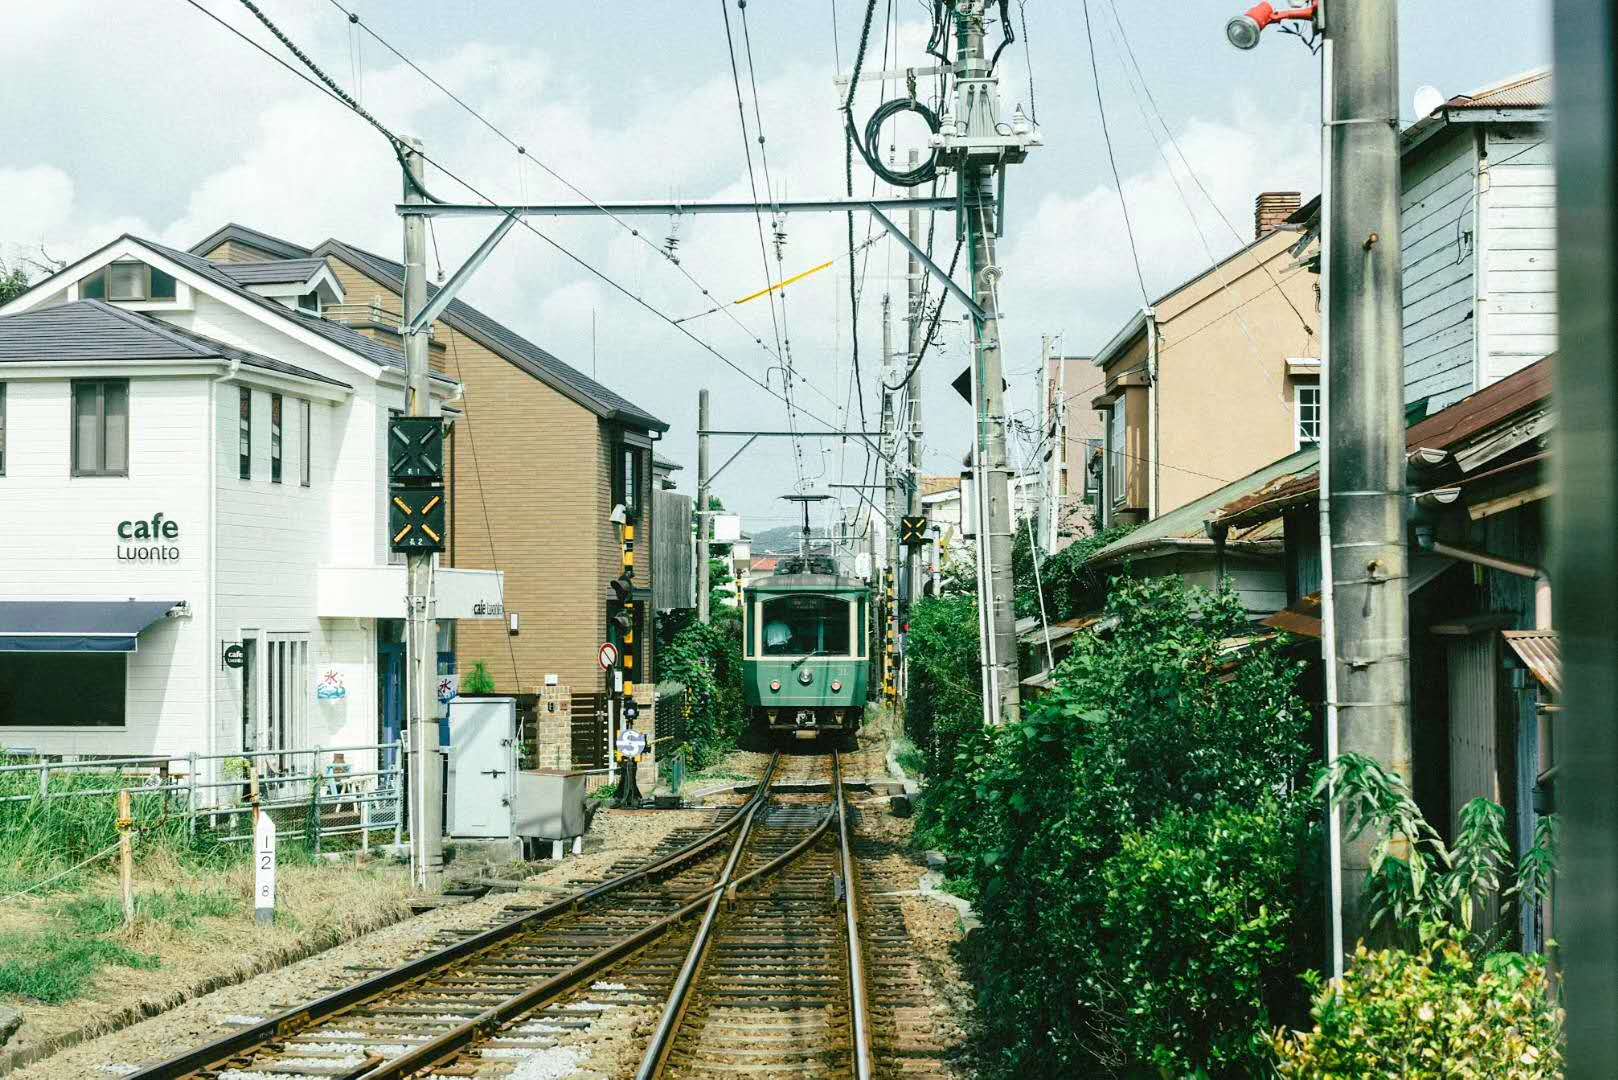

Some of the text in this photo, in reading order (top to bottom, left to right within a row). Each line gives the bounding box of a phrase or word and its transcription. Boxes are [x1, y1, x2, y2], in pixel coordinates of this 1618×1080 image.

[117, 512, 179, 539] cafe
[117, 545, 179, 560] Luonto
[473, 600, 486, 615] cafe
[439, 678, 451, 693] 氷
[261, 856, 271, 870] 2
[262, 885, 269, 897] 8
